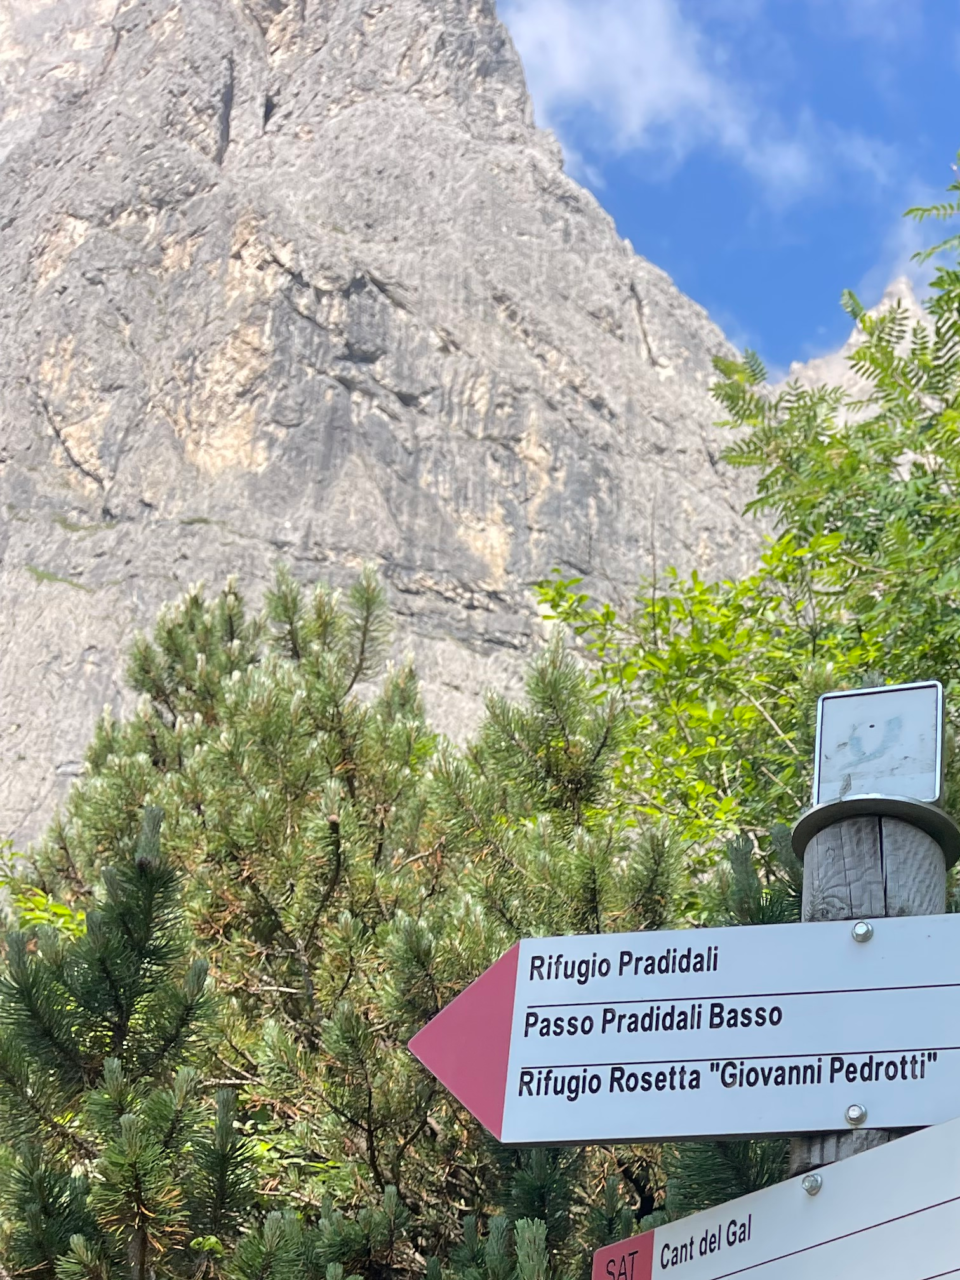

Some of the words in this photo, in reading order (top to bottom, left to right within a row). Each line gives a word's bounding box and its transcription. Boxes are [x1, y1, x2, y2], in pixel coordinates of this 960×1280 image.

[529, 953, 610, 985] Rifugio
[619, 946, 719, 977] Pradidali
[524, 1012, 594, 1037] Passo
[601, 1003, 702, 1034] Pradidali
[709, 1003, 783, 1029] Basso
[518, 1068, 601, 1101] Rifugio
[609, 1065, 701, 1093] Rosetta
[710, 1058, 822, 1089] "Giovanni
[830, 1052, 938, 1085] Pedrotti"
[660, 1236, 694, 1270] Cant
[699, 1225, 721, 1257] del
[726, 1214, 751, 1247] Gal
